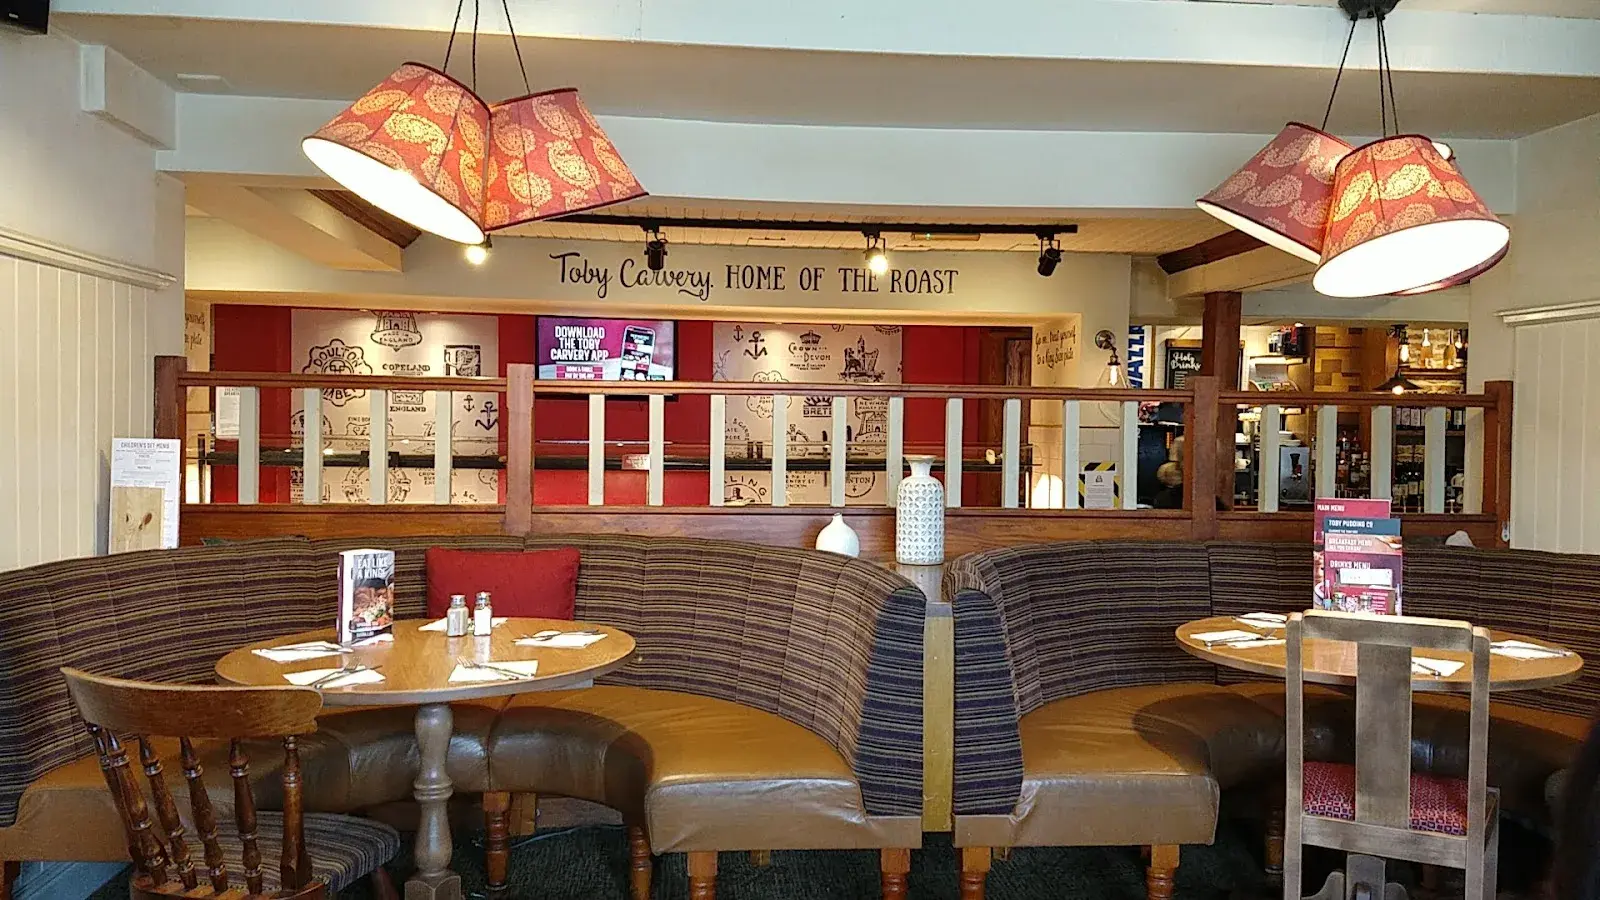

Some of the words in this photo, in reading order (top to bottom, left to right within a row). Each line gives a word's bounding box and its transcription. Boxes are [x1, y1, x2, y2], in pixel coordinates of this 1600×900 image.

[549, 252, 613, 299] Toby
[725, 264, 786, 291] HOME
[799, 267, 826, 292] OF
[838, 267, 879, 293] THE
[889, 268, 959, 294] ROAST
[554, 326, 605, 339] DOWNLOAD
[559, 338, 576, 350] THE
[578, 338, 601, 350] TOBY
[550, 349, 590, 361] CARVERY
[591, 350, 609, 361] APP
[382, 363, 431, 371] COPELAND
[1170, 360, 1202, 371] Drinks
[121, 441, 147, 449] CHILDREN'S
[1342, 520, 1366, 528] PUDDING
[357, 558, 371, 568] EAT
[1329, 560, 1352, 569] DRINKS
[1353, 561, 1371, 569] MENU
